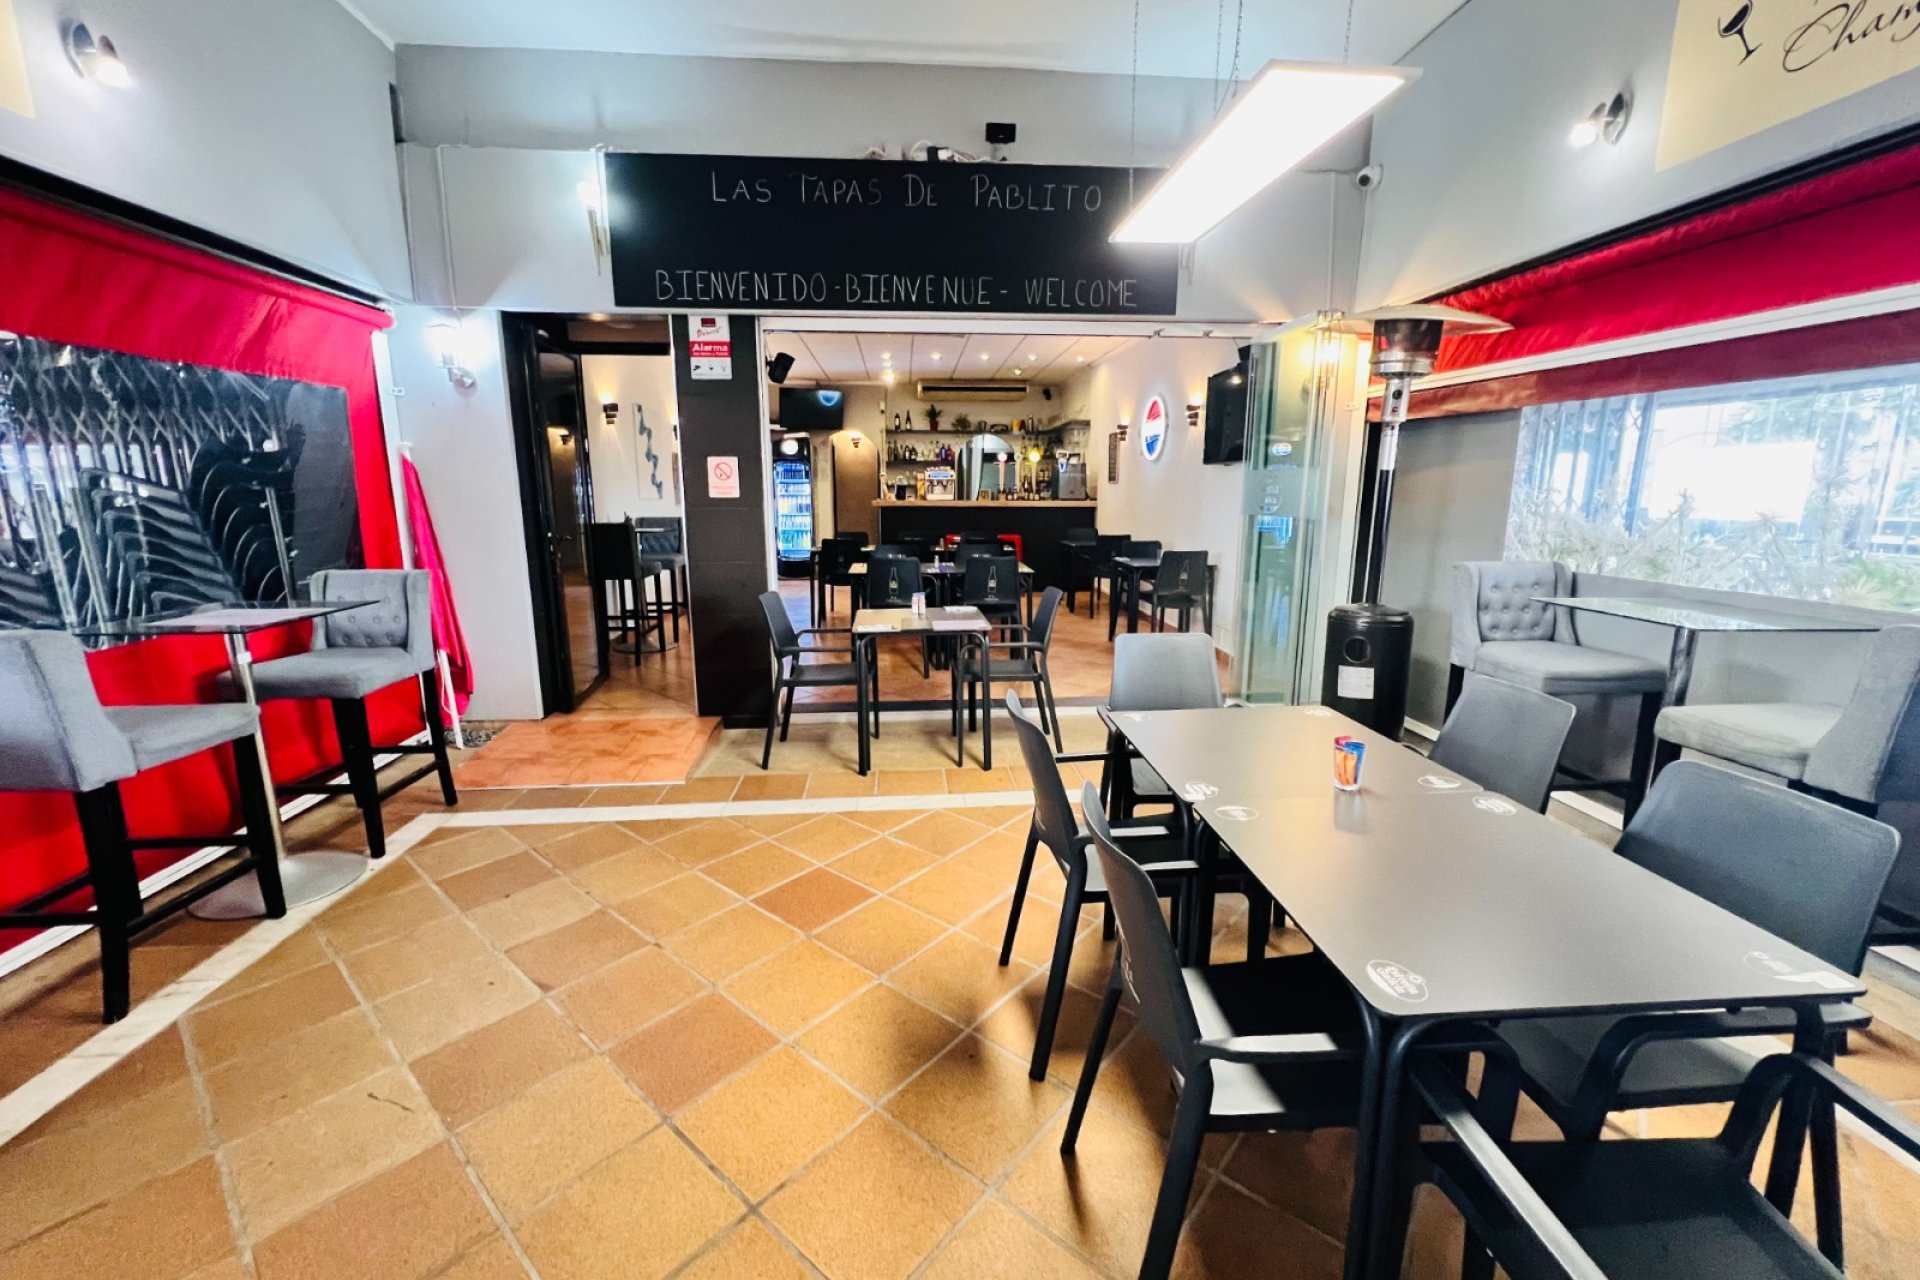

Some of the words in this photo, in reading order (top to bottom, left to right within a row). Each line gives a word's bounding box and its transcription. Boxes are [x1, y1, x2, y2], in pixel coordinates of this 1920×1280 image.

[712, 171, 772, 203] LAS
[789, 172, 882, 205] TAPAS
[902, 173, 938, 207] DE
[970, 174, 1102, 211] PABLITO
[655, 269, 827, 302] BIENVENIDO
[845, 273, 994, 305] BIENVENUE
[1025, 278, 1138, 308] WELCOME
[692, 343, 729, 352] Alarma
